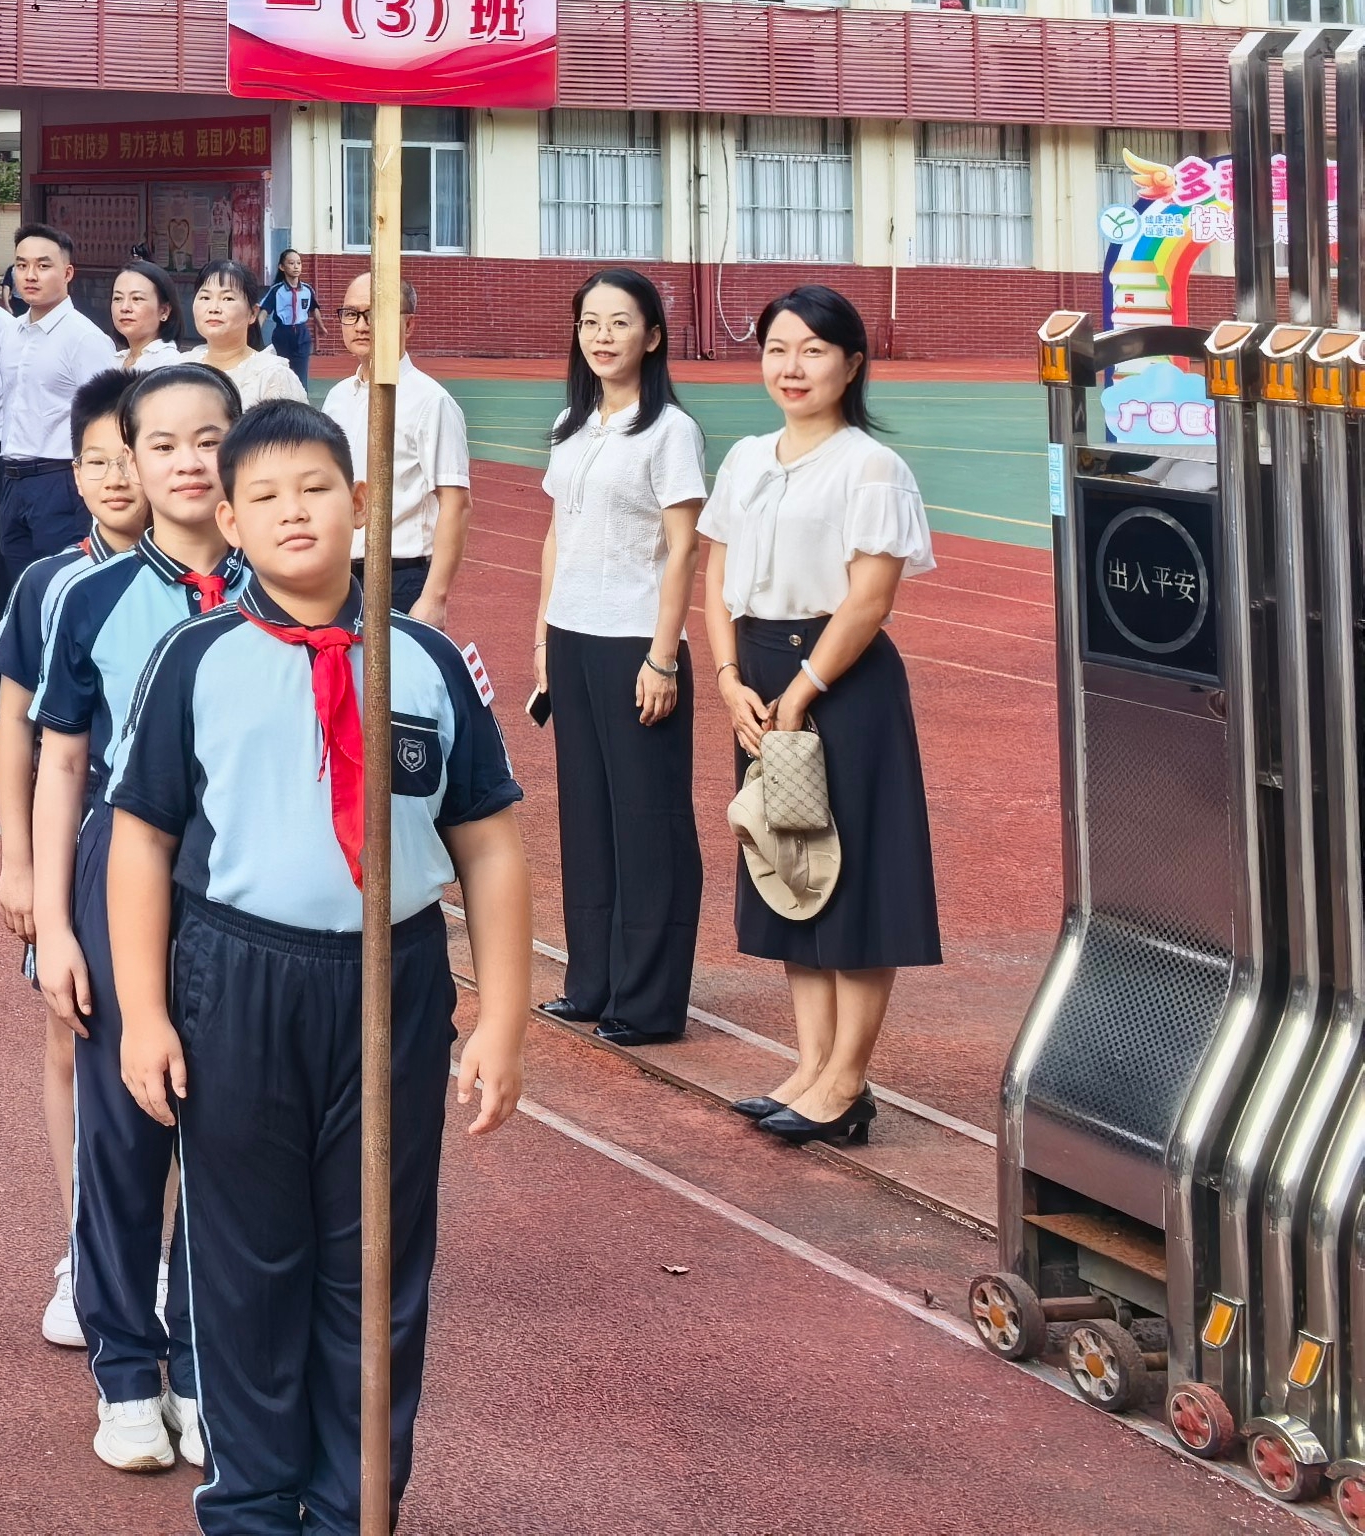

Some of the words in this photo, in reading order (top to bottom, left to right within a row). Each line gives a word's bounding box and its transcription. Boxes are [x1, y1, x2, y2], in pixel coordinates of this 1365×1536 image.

[1118, 399, 1215, 436] 广西医
[1108, 558, 1196, 603] 出入平安
